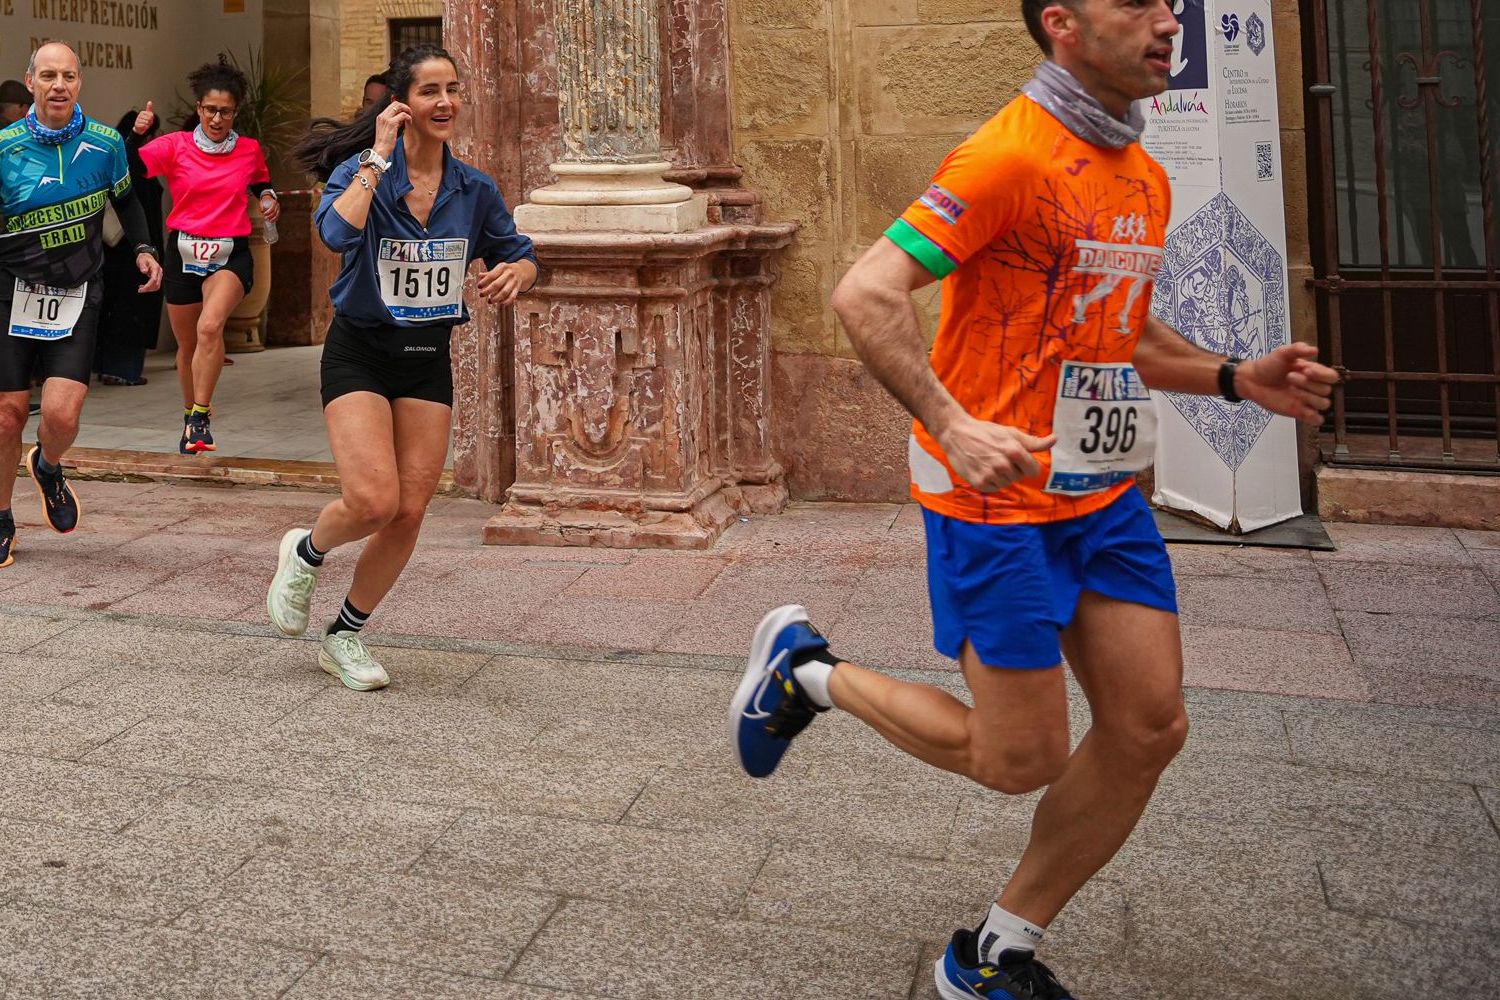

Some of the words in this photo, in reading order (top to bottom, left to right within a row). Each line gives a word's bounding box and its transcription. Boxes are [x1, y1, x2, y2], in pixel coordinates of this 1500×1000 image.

[23, 207, 63, 229] LUCES
[42, 227, 84, 247] TRAIL
[191, 242, 220, 261] 122
[391, 242, 420, 261] 21K
[390, 267, 450, 298] 1519
[37, 297, 59, 321] 10
[1078, 368, 1115, 400] 21K
[1080, 406, 1138, 454] 396
